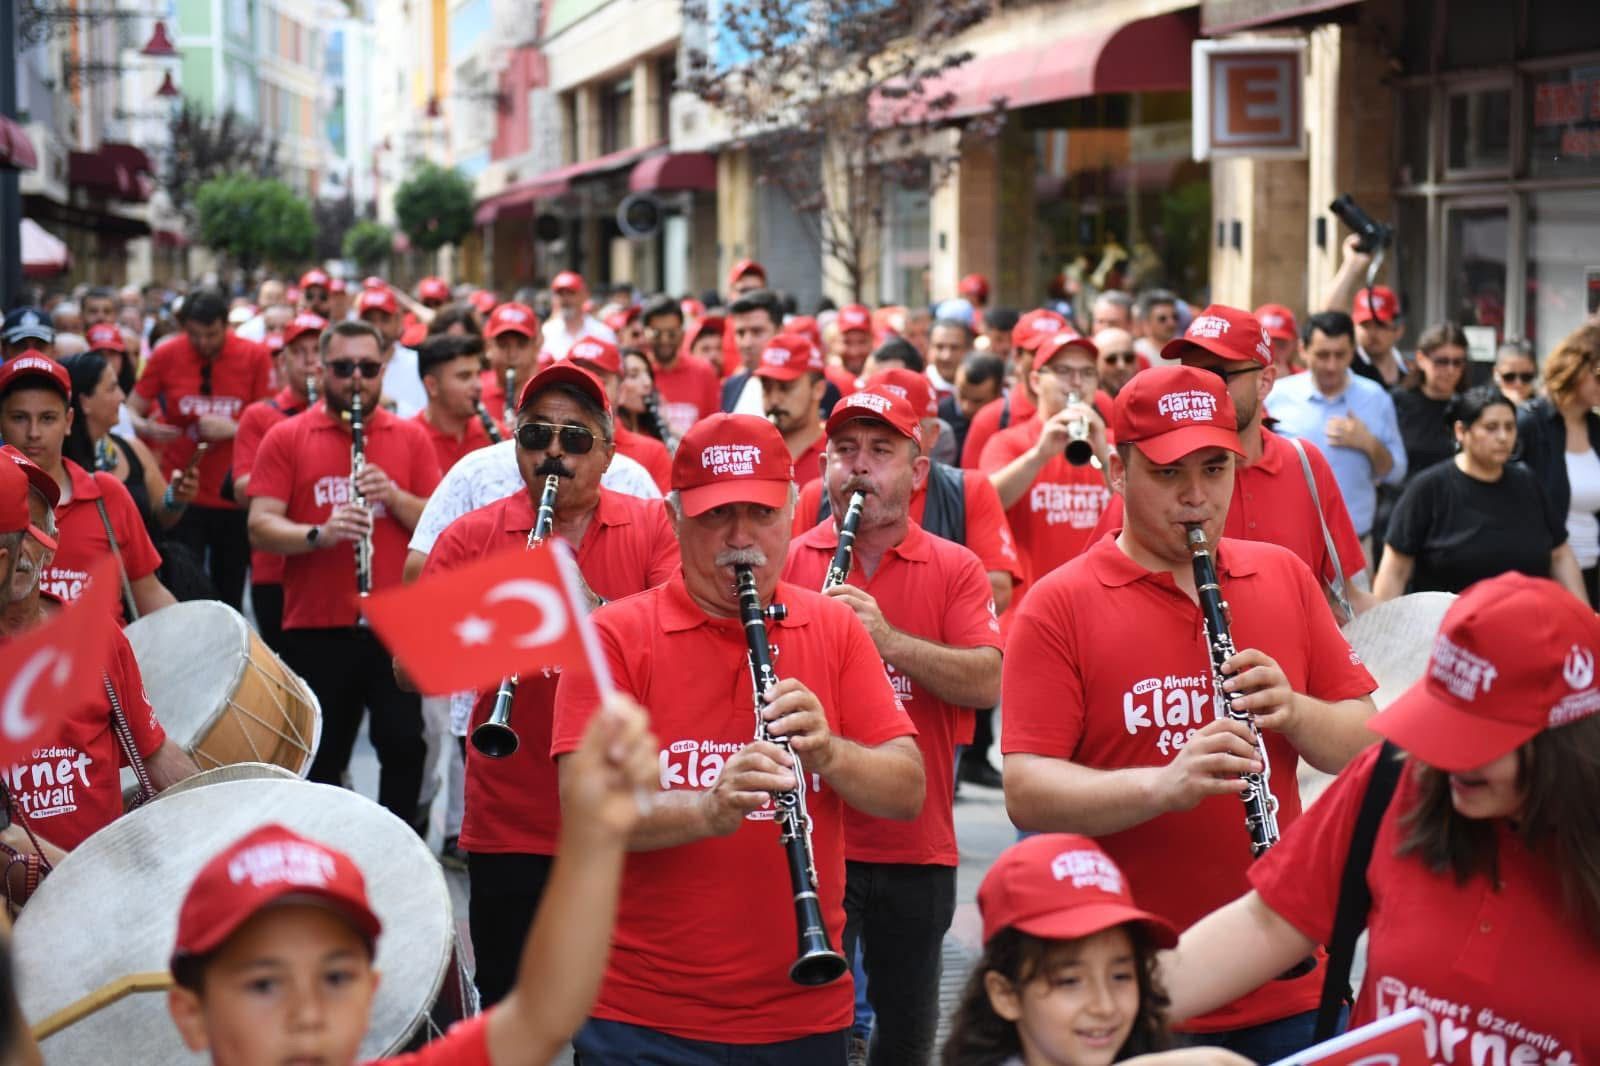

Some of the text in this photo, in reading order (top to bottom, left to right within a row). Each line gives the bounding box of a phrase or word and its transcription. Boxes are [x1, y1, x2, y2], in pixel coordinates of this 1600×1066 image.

[1227, 67, 1280, 134] E
[1158, 394, 1217, 417] klarnet
[701, 447, 761, 469] klarnet
[1164, 675, 1207, 689] Ahmet
[1123, 688, 1209, 735] klar
[1, 753, 93, 790] rnet
[12, 785, 75, 813] tivali
[1409, 986, 1471, 1023] Ahmet
[1476, 1007, 1560, 1052] Özdemir
